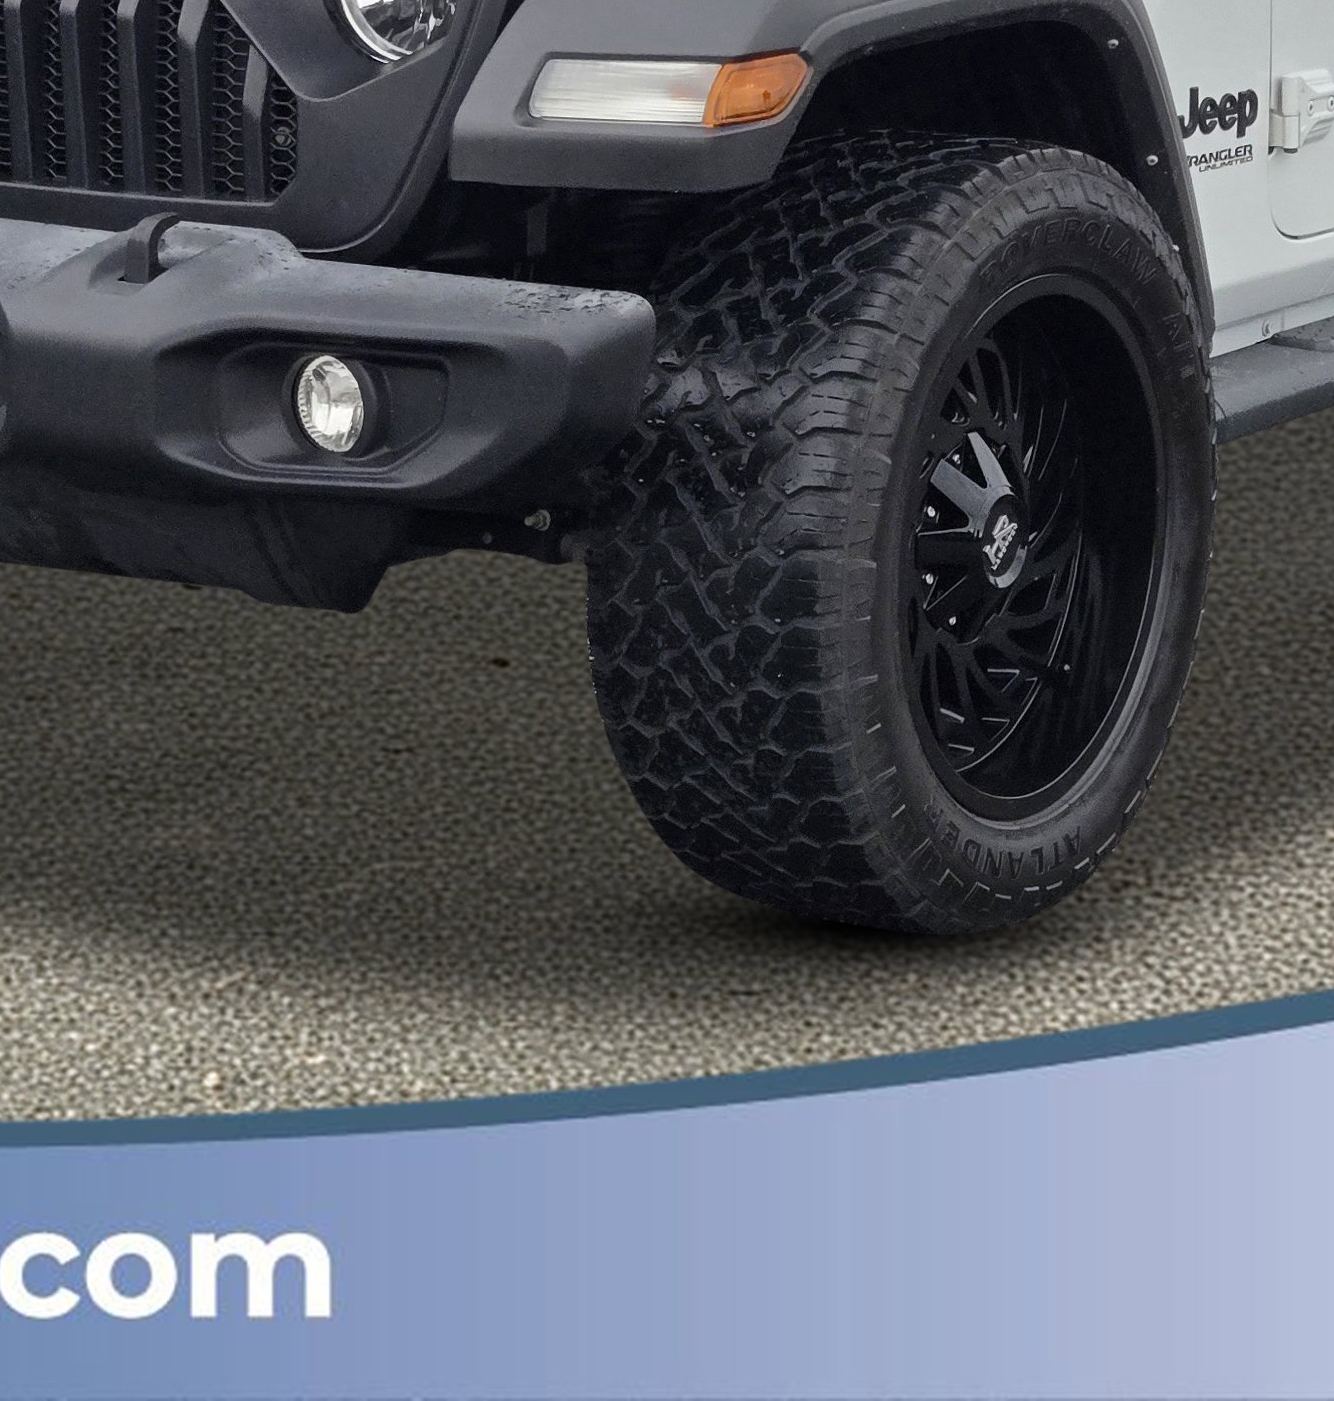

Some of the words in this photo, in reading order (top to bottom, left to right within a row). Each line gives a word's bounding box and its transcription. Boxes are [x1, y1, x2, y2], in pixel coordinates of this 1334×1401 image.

[1177, 86, 1258, 139] Jeep
[1187, 144, 1253, 167] RANGLER
[1199, 156, 1253, 172] UNLIMITED
